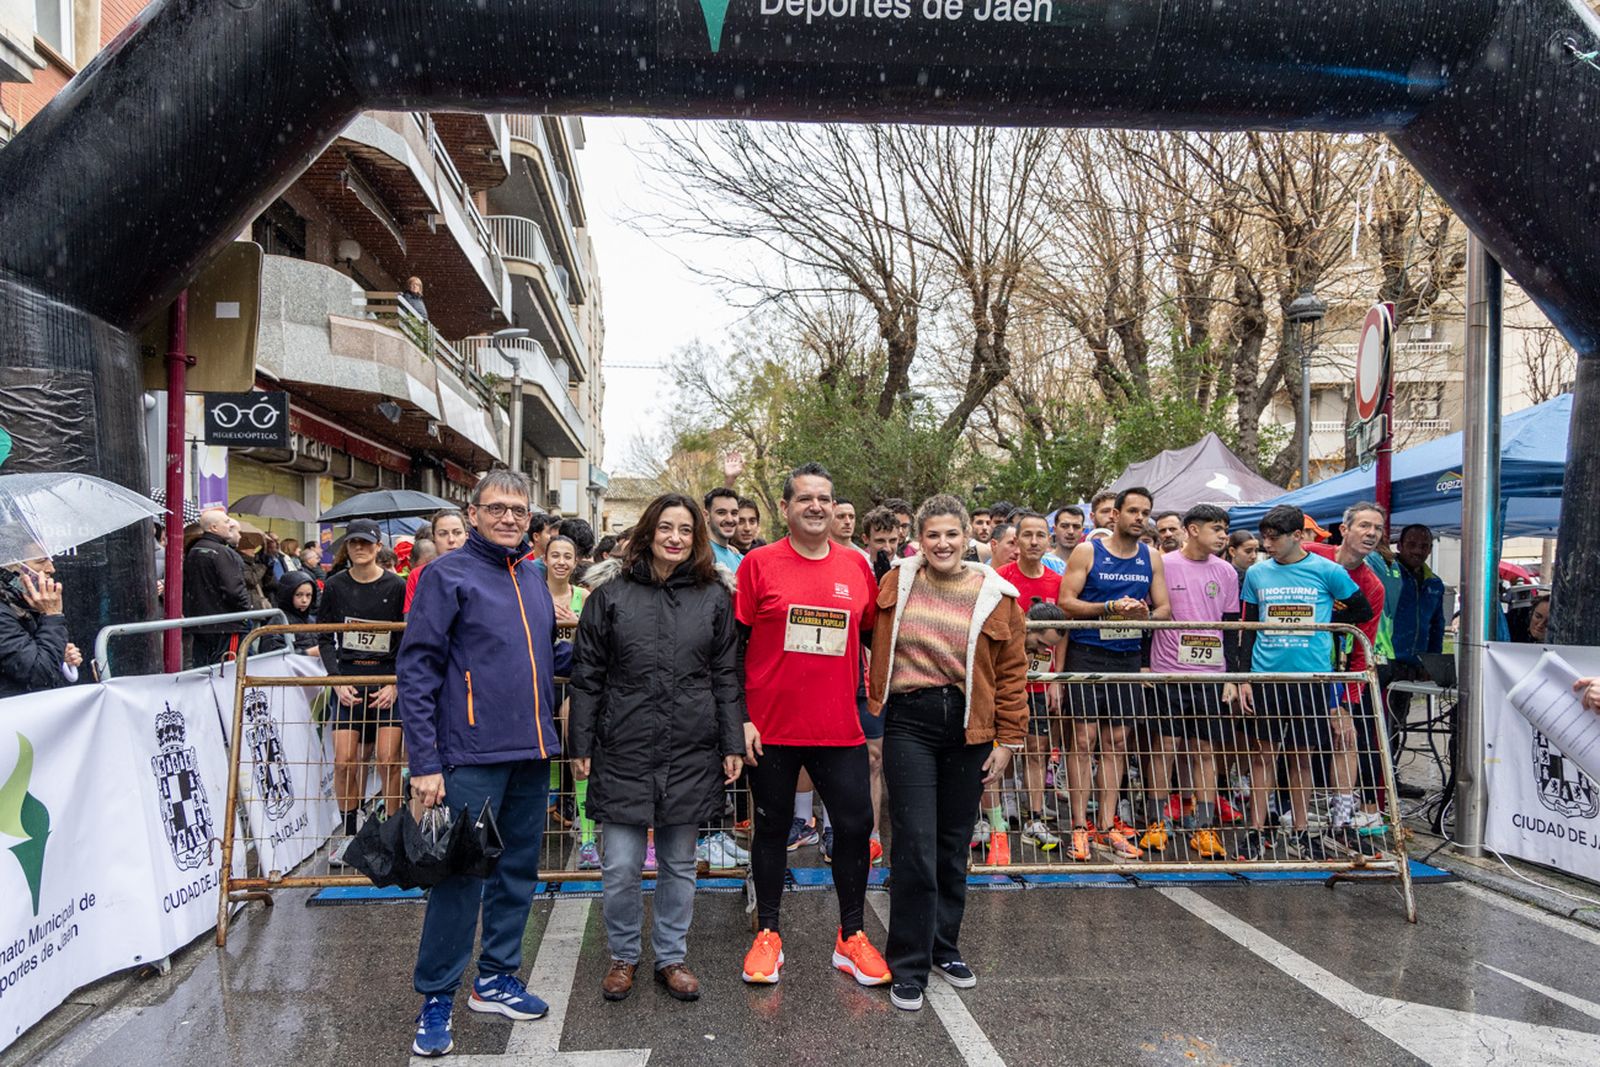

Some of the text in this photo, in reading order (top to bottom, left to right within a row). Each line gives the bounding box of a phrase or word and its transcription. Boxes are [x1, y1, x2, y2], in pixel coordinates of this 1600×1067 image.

[922, 0, 963, 20] de
[1099, 572, 1149, 583] TROTASIERRA
[1265, 587, 1318, 595] NOCTURNA
[797, 615, 821, 625] CARRERA
[823, 618, 845, 628] POPULAR
[357, 633, 376, 645] 157
[816, 627, 822, 645] 1
[1191, 647, 1212, 659] 579
[1512, 813, 1565, 838] CIUDAD
[1568, 827, 1587, 846] DE
[200, 874, 212, 894] DE
[79, 892, 96, 912] de
[40, 942, 54, 963] de
